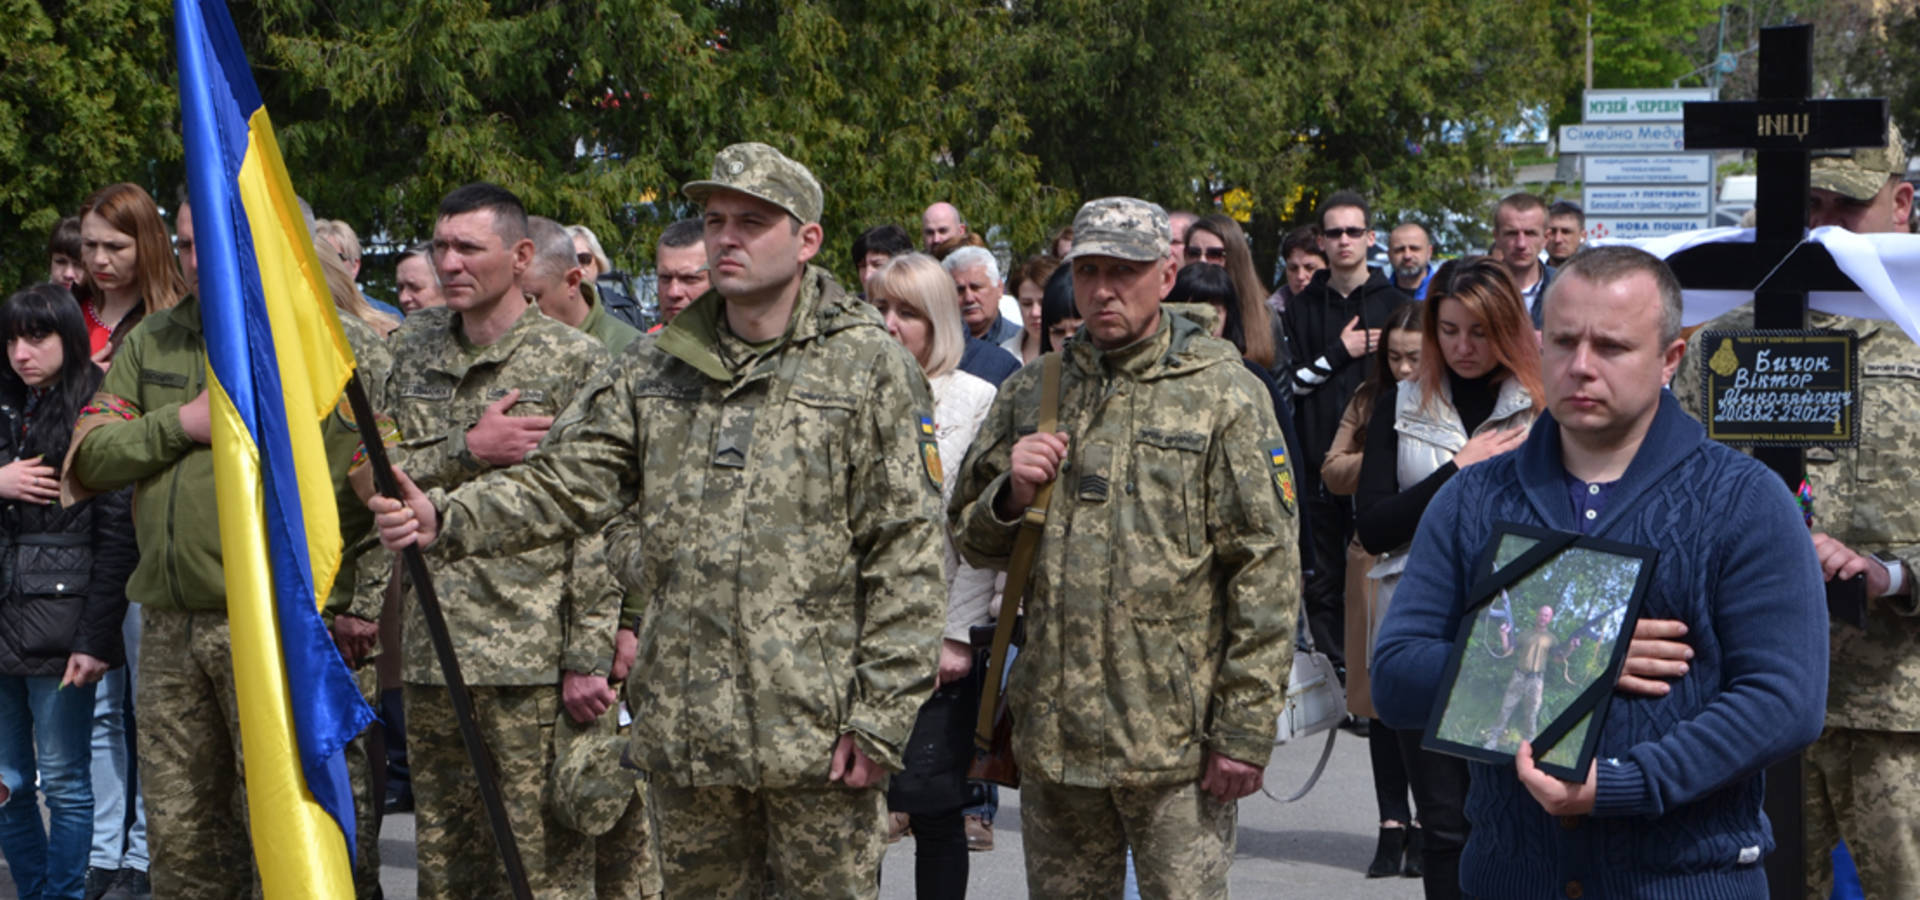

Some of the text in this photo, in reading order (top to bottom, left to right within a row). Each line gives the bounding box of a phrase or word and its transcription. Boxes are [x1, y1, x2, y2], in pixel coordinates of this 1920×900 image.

[1589, 97, 1628, 113] МУЗЕЙ
[1638, 126, 1685, 140] Меди
[1615, 221, 1699, 231] НОВА ПОШТА
[1755, 348, 1831, 373] Бичок
[1733, 366, 1814, 389] Віктор
